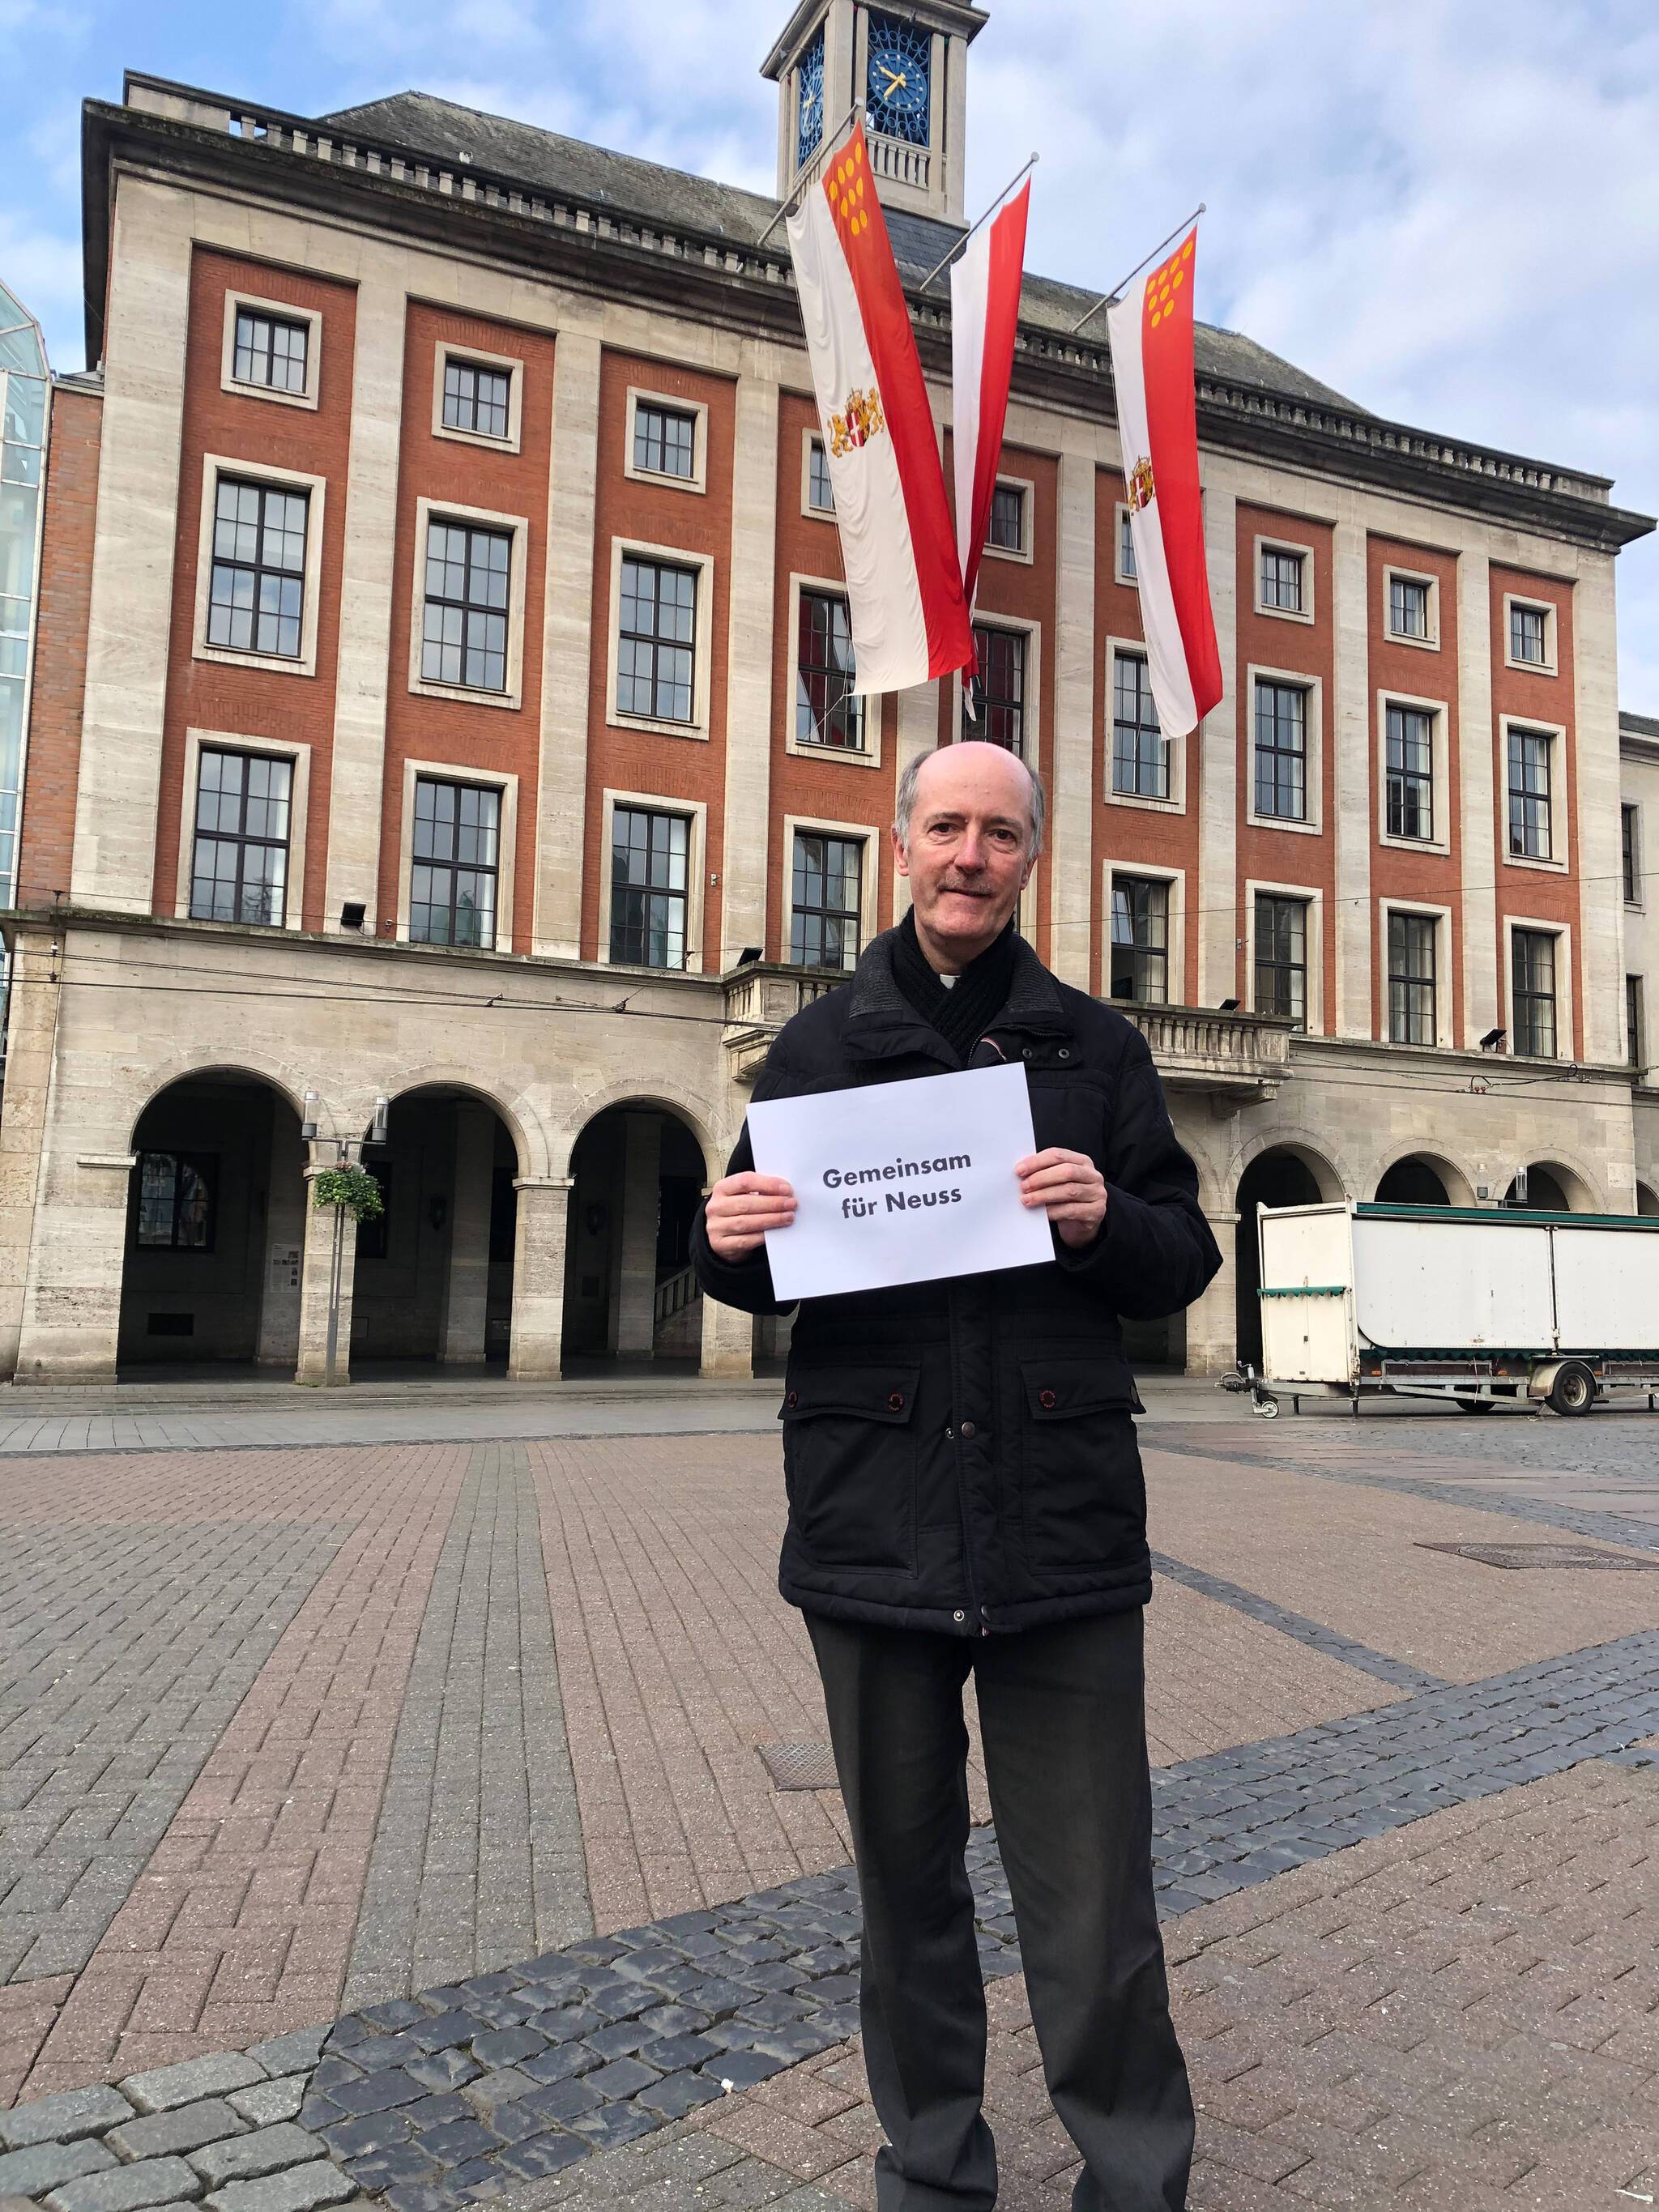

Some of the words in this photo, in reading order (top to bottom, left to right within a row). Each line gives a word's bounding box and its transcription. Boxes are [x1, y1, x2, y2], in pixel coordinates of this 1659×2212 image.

[822, 1154, 971, 1189] Gemeinsam
[841, 1196, 878, 1219] für
[885, 1188, 962, 1213] Neuss
